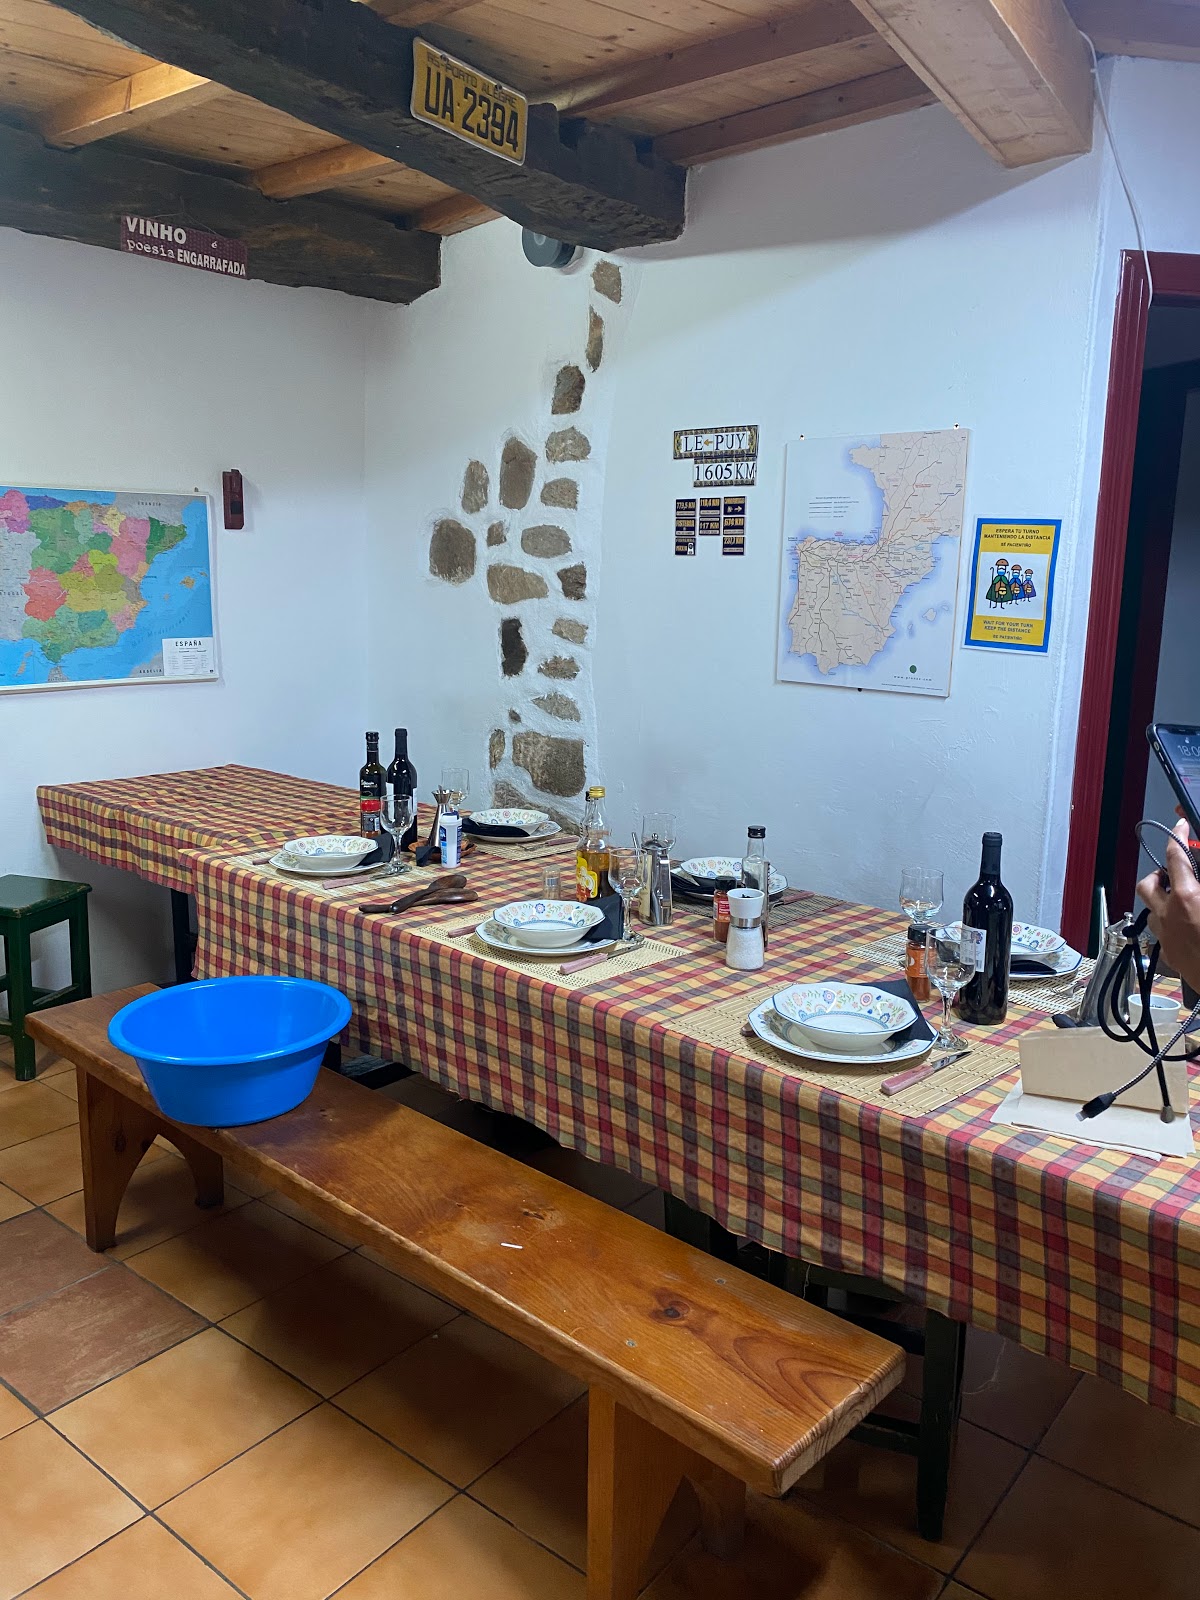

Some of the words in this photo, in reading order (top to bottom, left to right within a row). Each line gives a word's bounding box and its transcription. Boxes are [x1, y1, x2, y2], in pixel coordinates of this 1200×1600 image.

[424, 66, 455, 123] UA
[461, 86, 519, 152] 2394
[126, 216, 187, 244] VINHO
[126, 239, 175, 260] poesia
[177, 249, 246, 276] ENGARRAFADA
[684, 435, 704, 452] LE
[714, 433, 746, 451] PUY
[695, 463, 733, 481] 1605
[735, 462, 757, 480] KM
